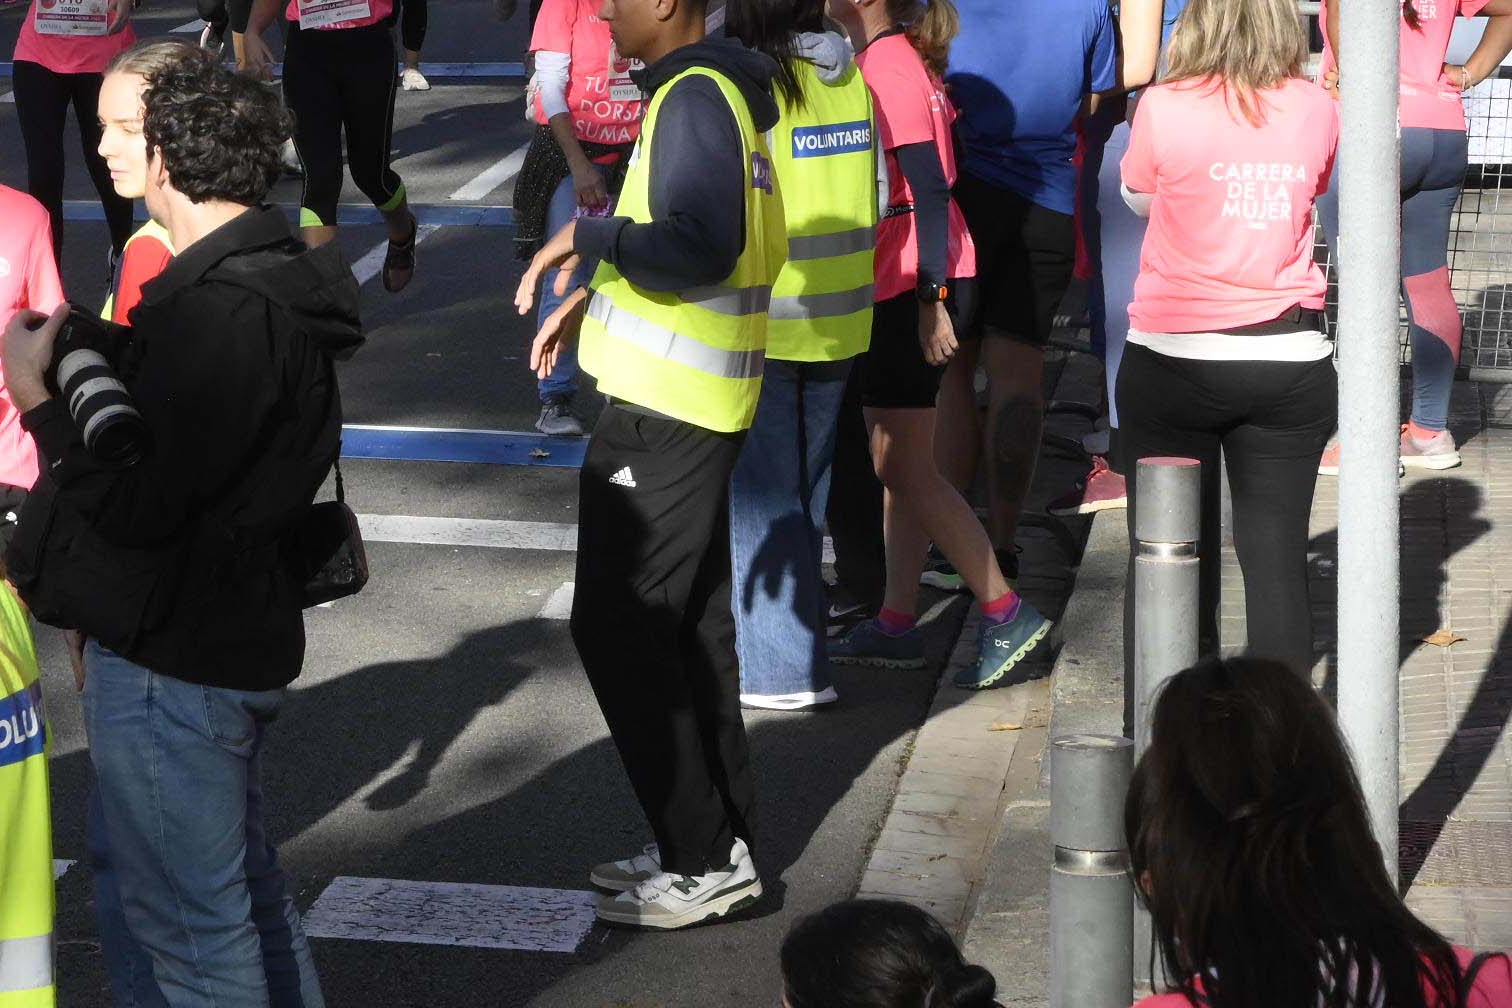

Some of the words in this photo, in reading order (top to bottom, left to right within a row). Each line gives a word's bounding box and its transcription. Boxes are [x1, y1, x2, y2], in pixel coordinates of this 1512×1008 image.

[584, 76, 607, 94] TU
[576, 119, 632, 142] SUMA
[793, 127, 871, 151] VOLUNTARIS
[1209, 162, 1306, 182] CARRERA
[1226, 182, 1257, 201] DE
[1263, 181, 1290, 200] LA
[1220, 200, 1291, 221] MUJER
